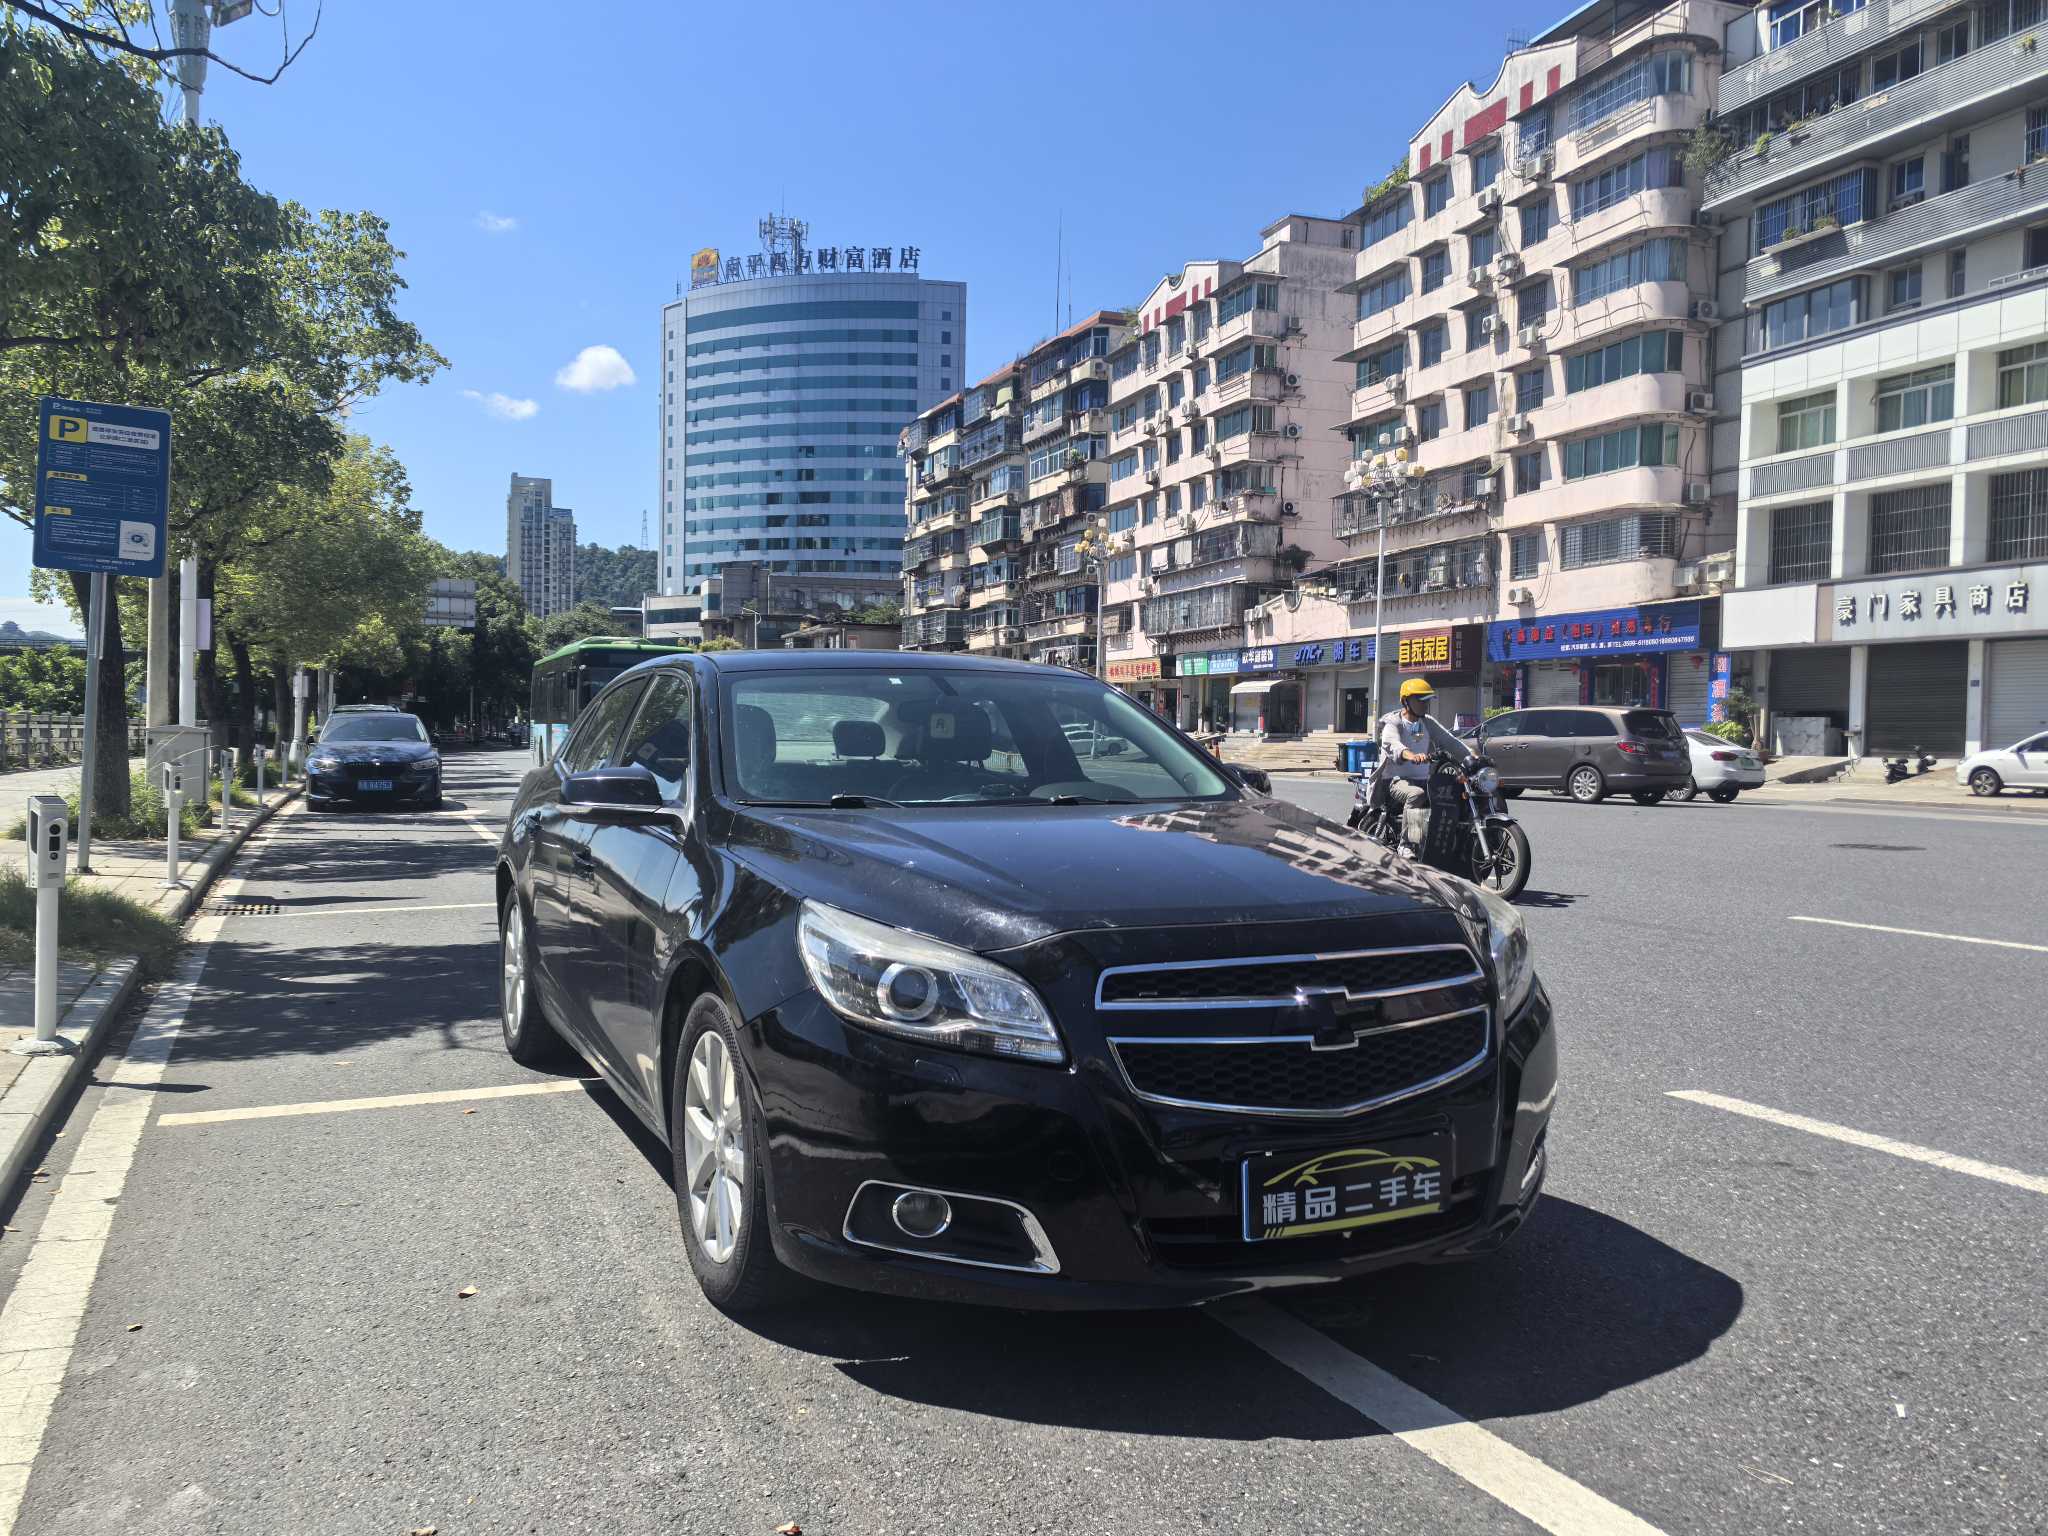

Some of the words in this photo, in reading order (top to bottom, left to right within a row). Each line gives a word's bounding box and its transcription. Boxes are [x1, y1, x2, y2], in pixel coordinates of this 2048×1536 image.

[59, 419, 80, 438] P
[1836, 580, 2027, 620] 豪门家具商店
[1263, 1172, 1440, 1225] 精品二手车
